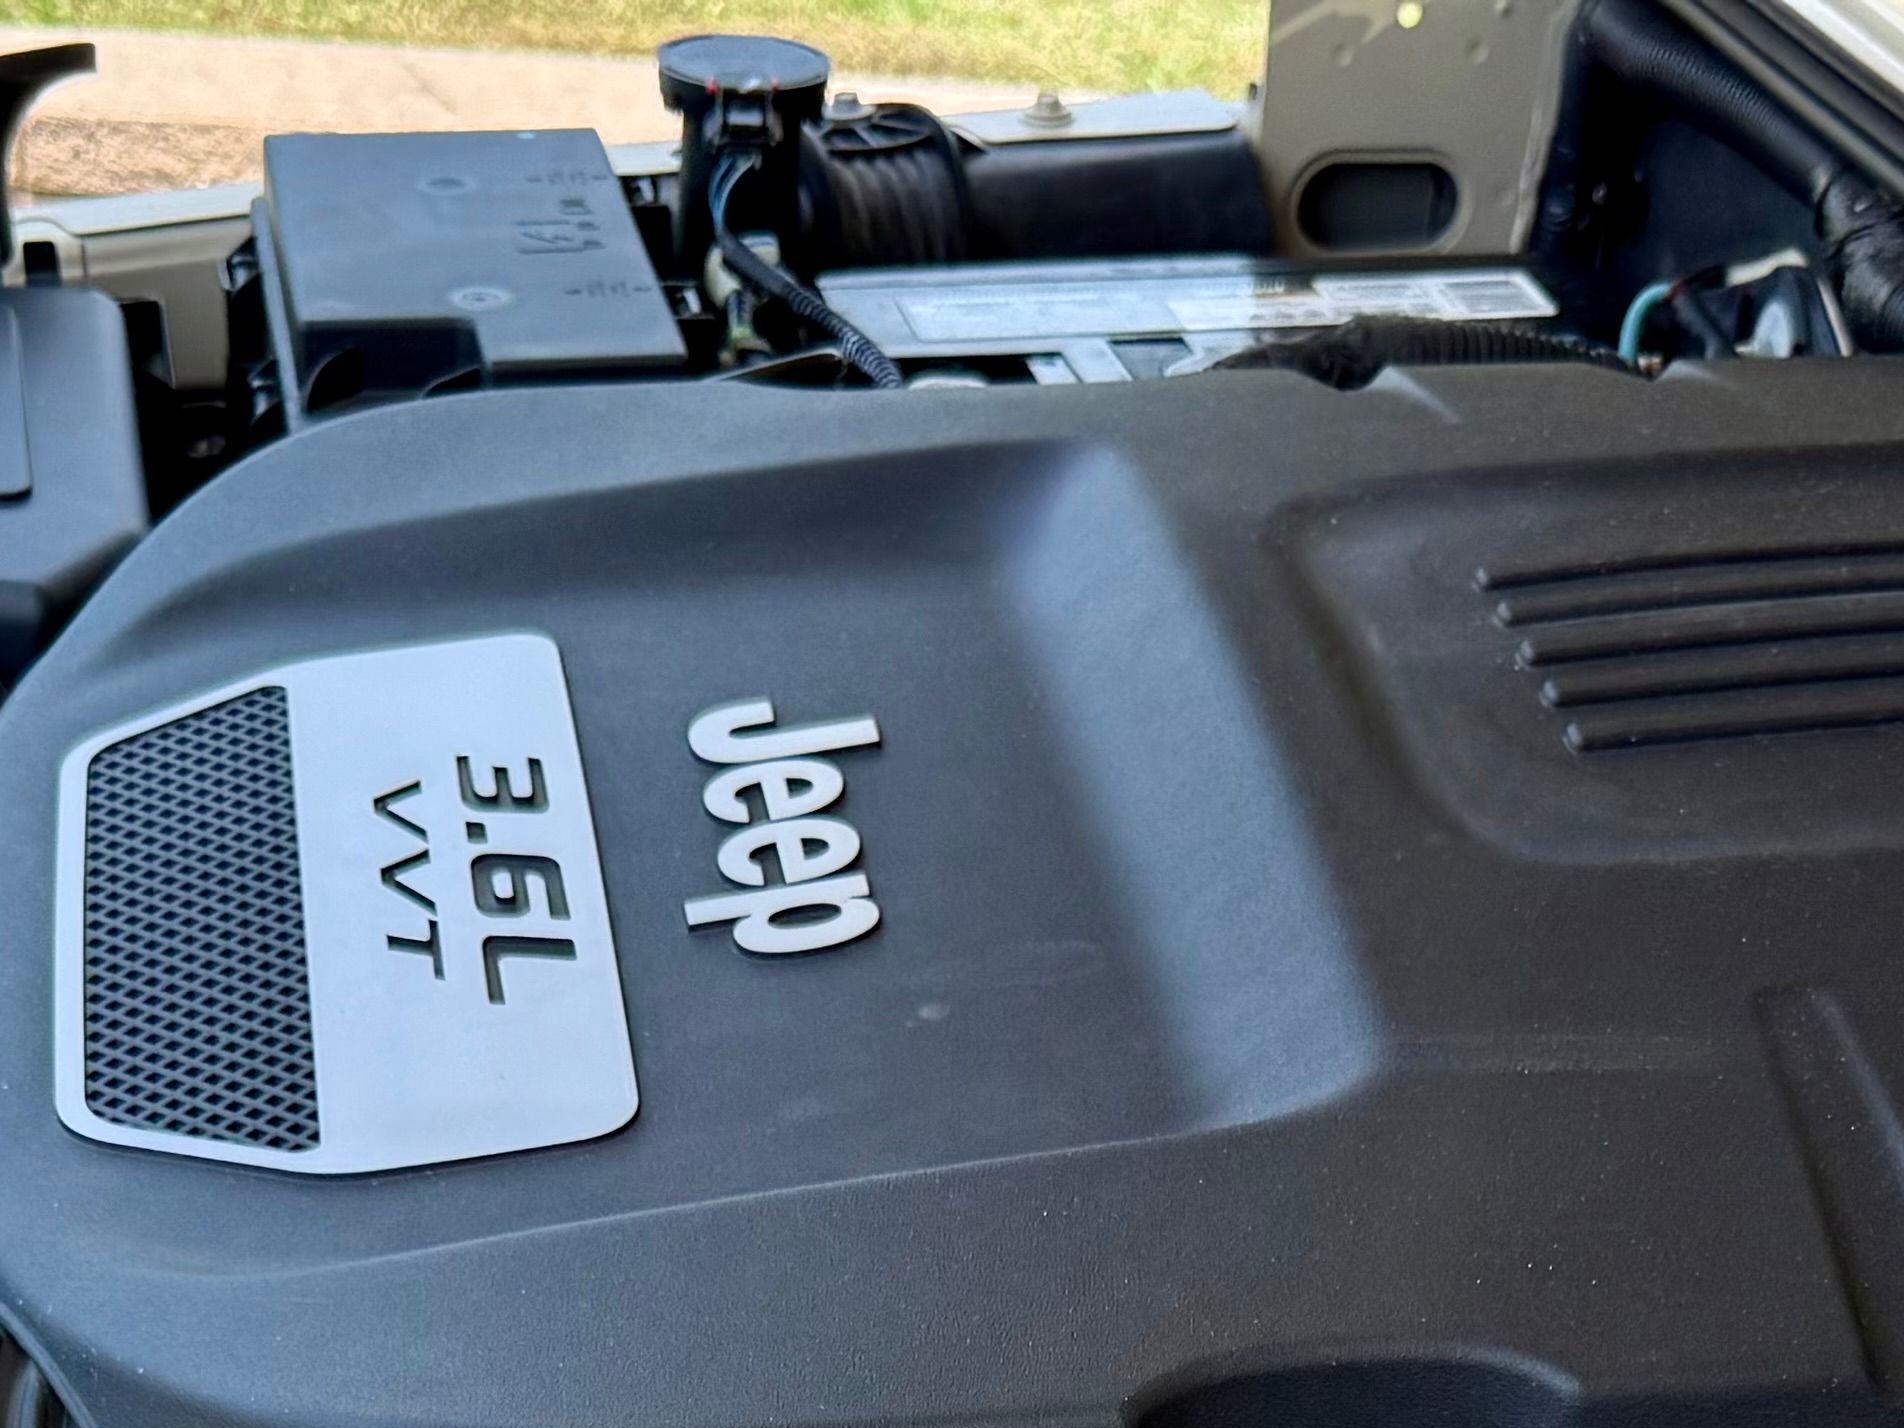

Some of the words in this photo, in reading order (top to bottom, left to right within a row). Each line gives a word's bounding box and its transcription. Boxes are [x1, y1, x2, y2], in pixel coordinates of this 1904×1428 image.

[372, 778, 445, 981] VVT
[457, 753, 578, 1006] 3.6L
[683, 695, 882, 957] Jeep
